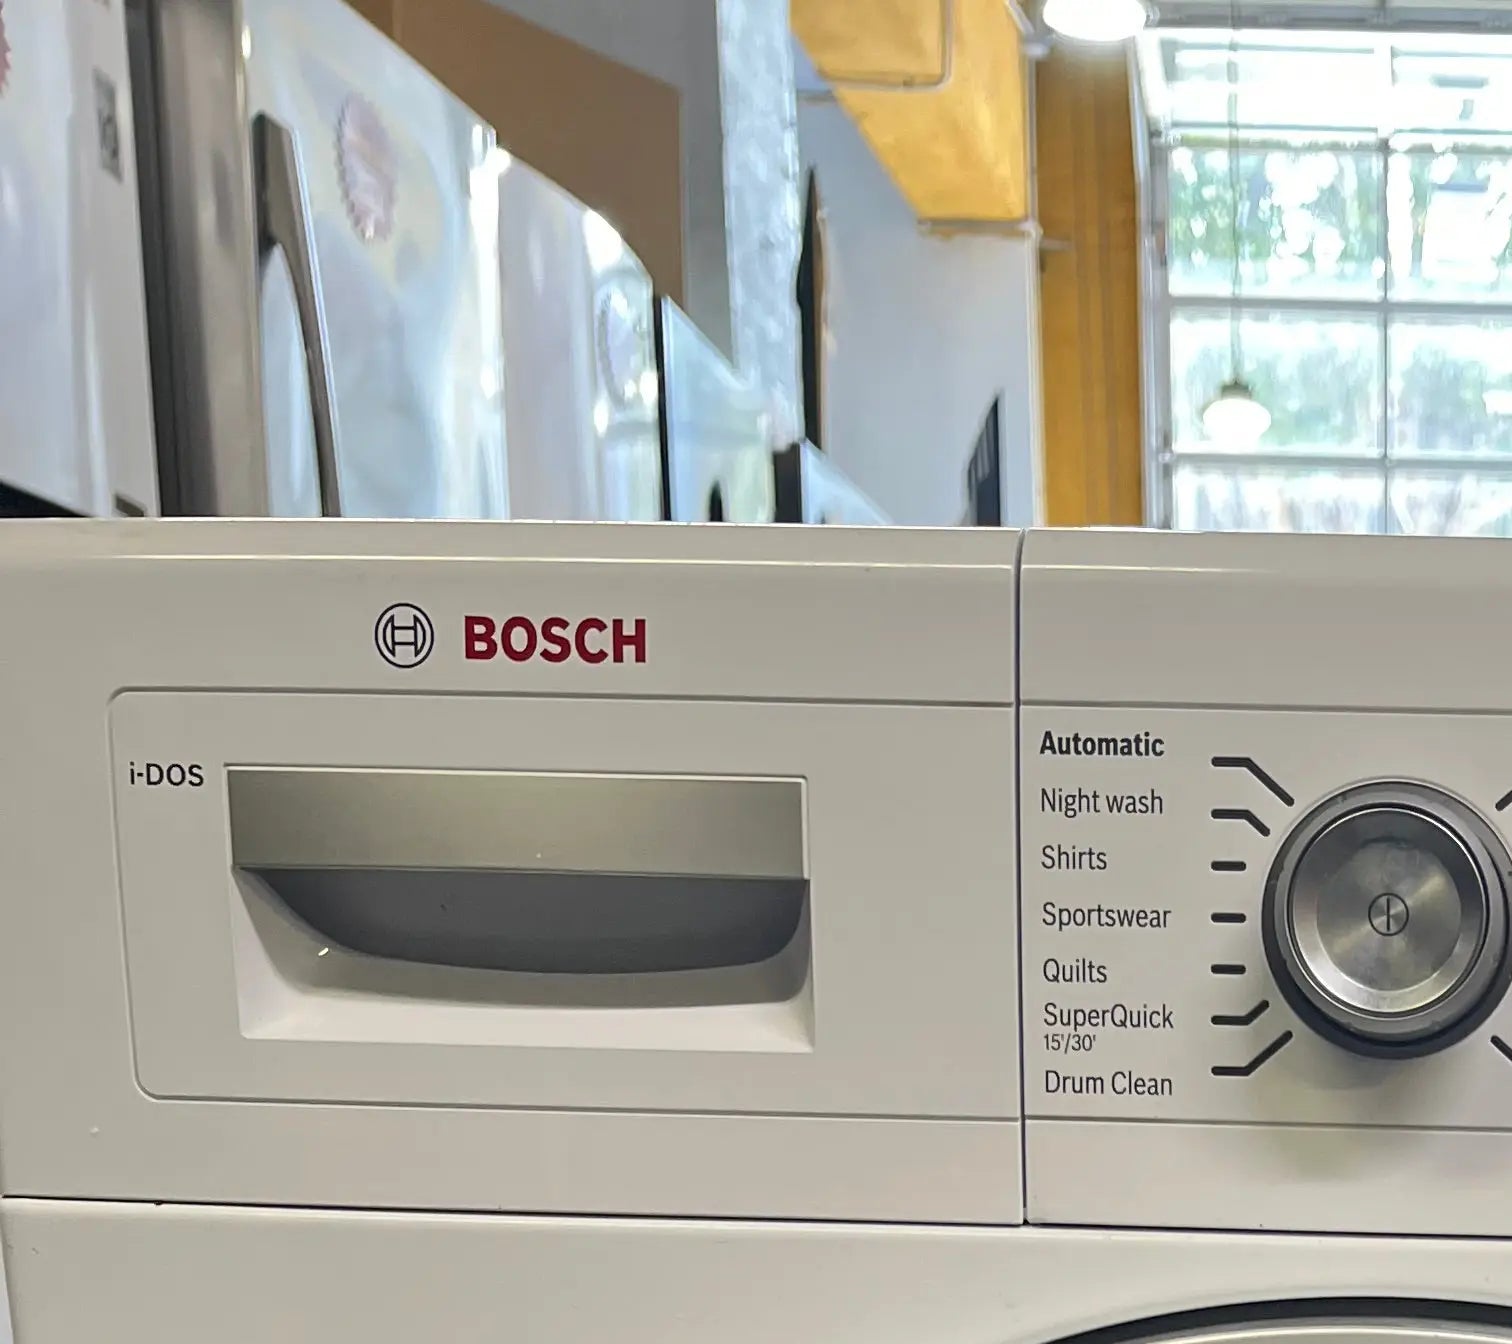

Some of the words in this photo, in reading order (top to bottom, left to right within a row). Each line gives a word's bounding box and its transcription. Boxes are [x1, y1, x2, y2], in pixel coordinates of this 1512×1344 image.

[464, 615, 647, 664] BOSCH
[1040, 730, 1165, 757] Automatic
[128, 761, 205, 788] i-DOS
[1040, 787, 1101, 819] Night
[1105, 788, 1164, 815] wash
[1040, 843, 1108, 871] Shirts
[1041, 901, 1172, 932] Sportswear
[1043, 957, 1108, 985] Quilts
[1043, 1002, 1175, 1033] SuperQuick
[1044, 1069, 1105, 1095] Drum
[1110, 1071, 1173, 1097] Clean
